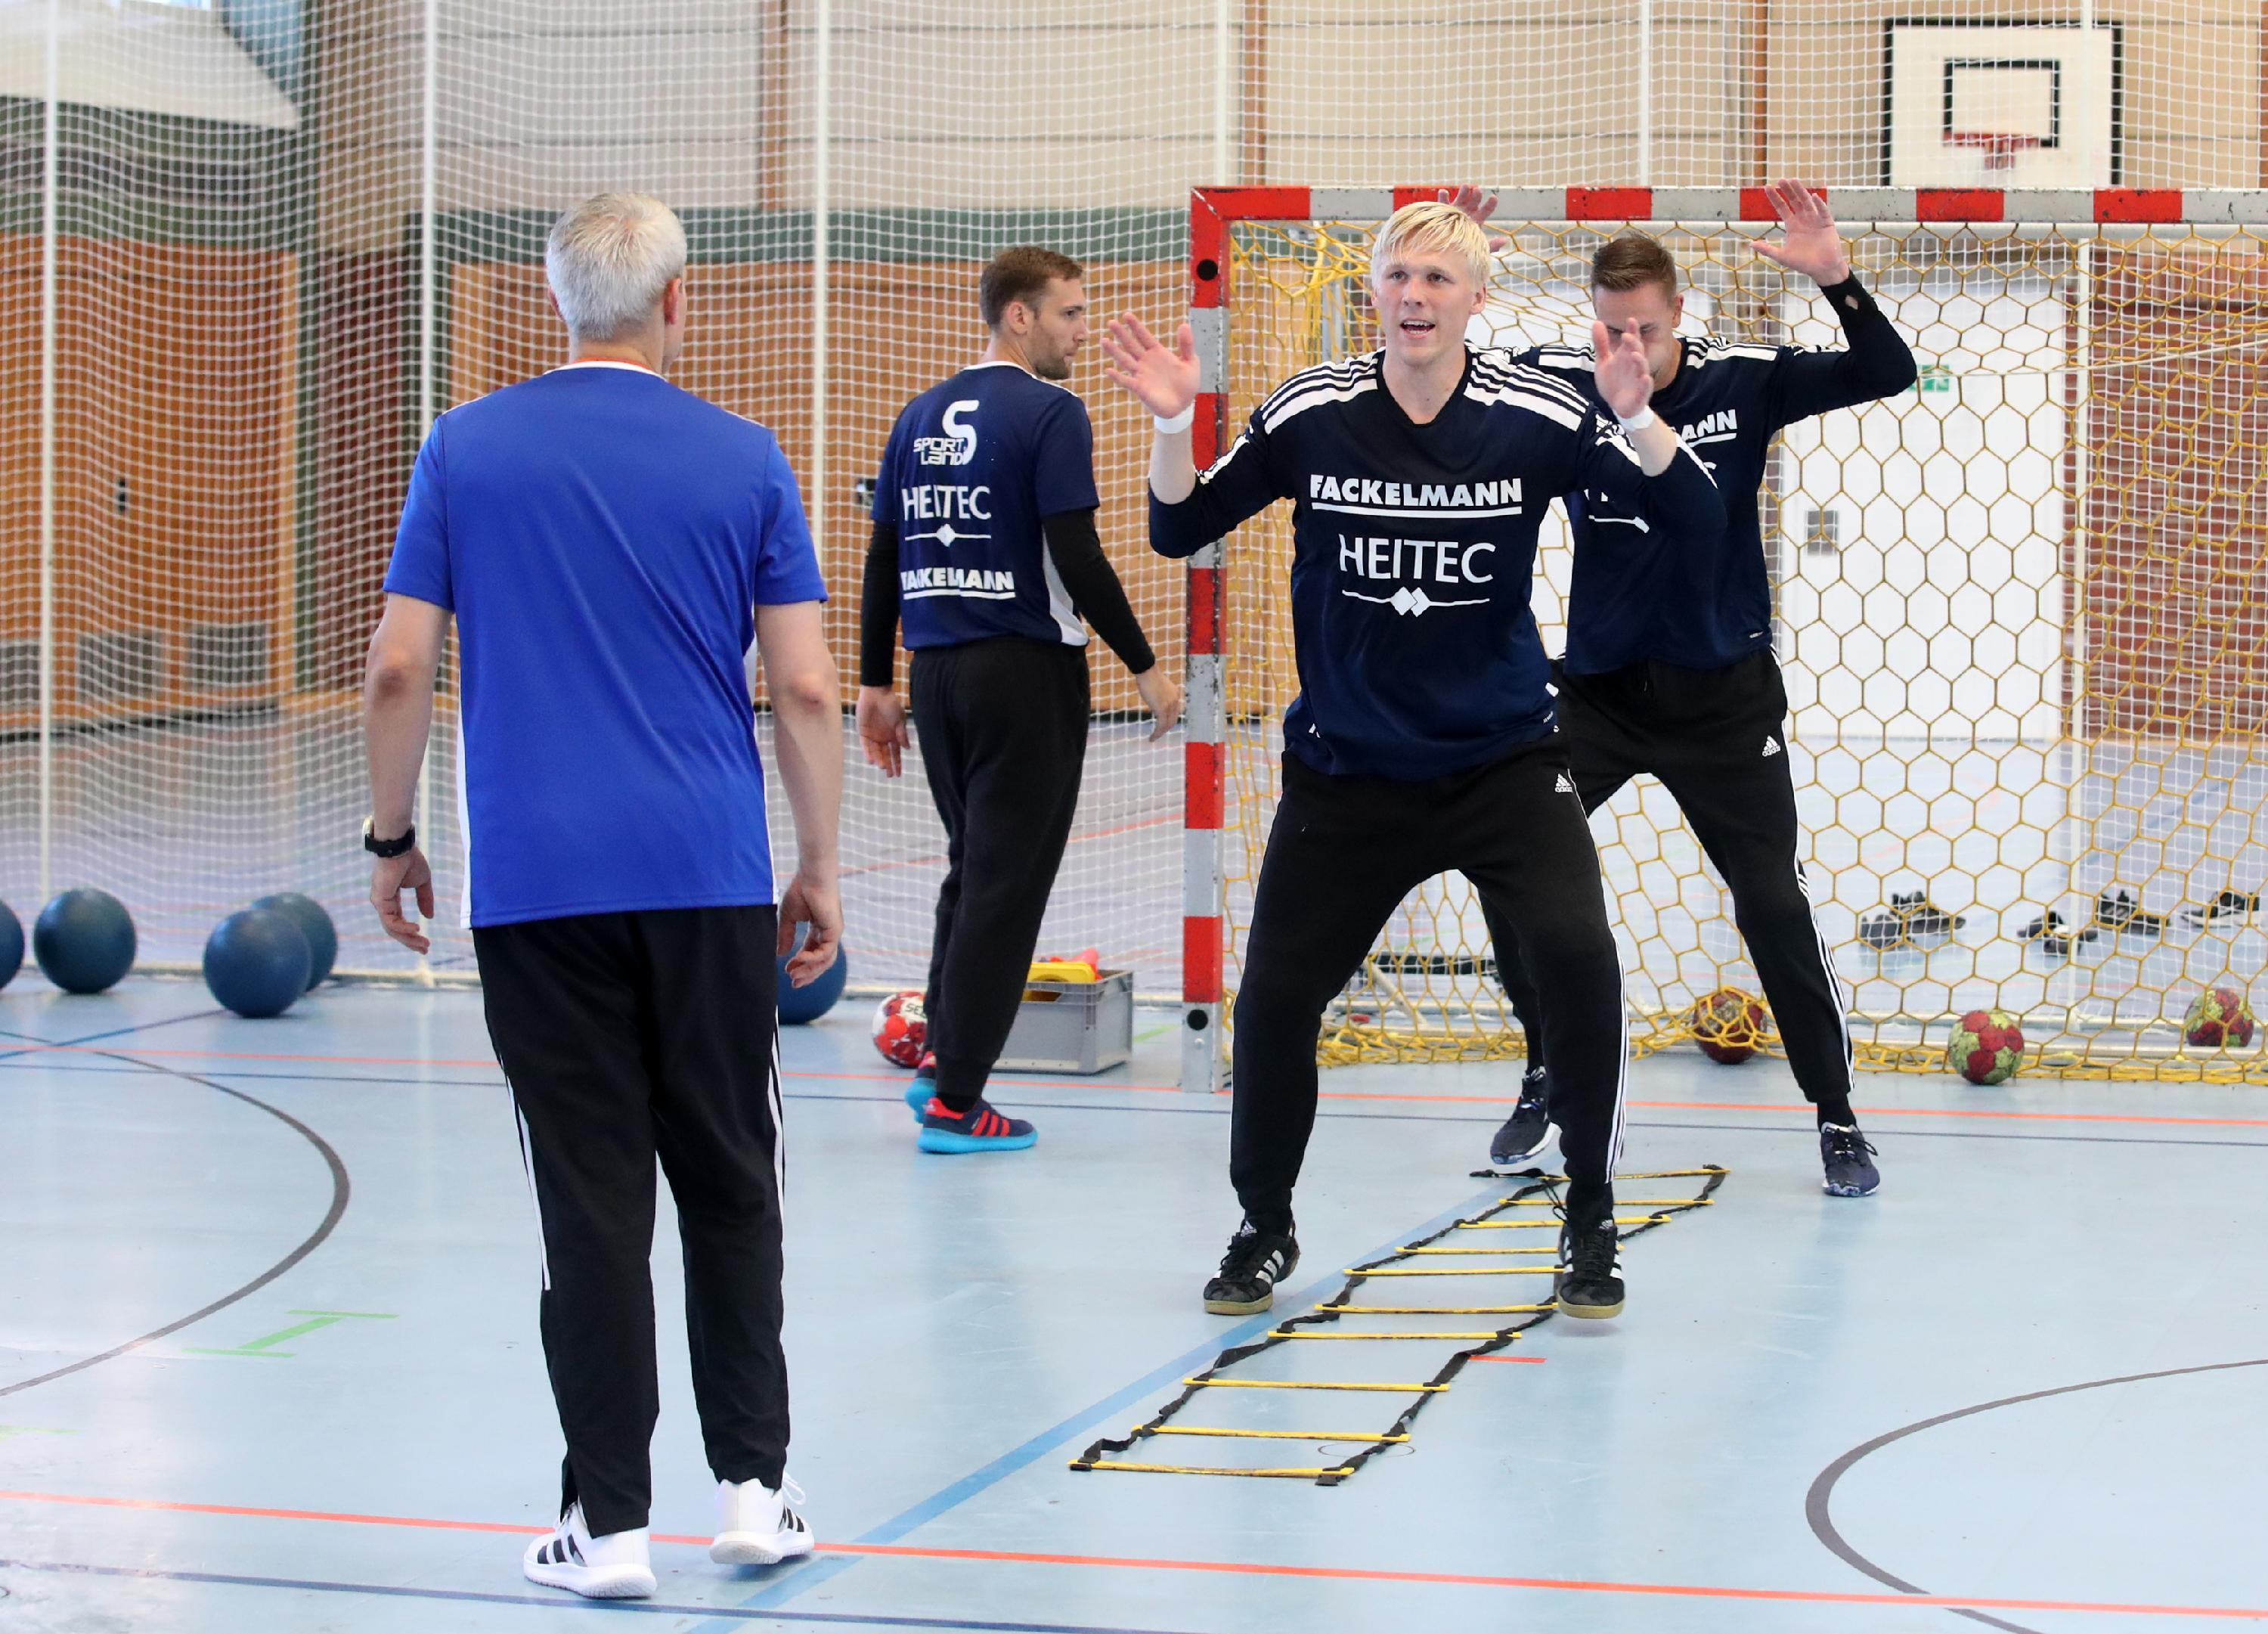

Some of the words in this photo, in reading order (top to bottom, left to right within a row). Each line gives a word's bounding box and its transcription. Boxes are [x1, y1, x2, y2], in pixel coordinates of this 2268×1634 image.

[913, 437, 965, 452] SPORT
[901, 485, 992, 522] HEITEC
[1309, 474, 1523, 507] FACKELMANN
[1339, 533, 1496, 584] HEITEC
